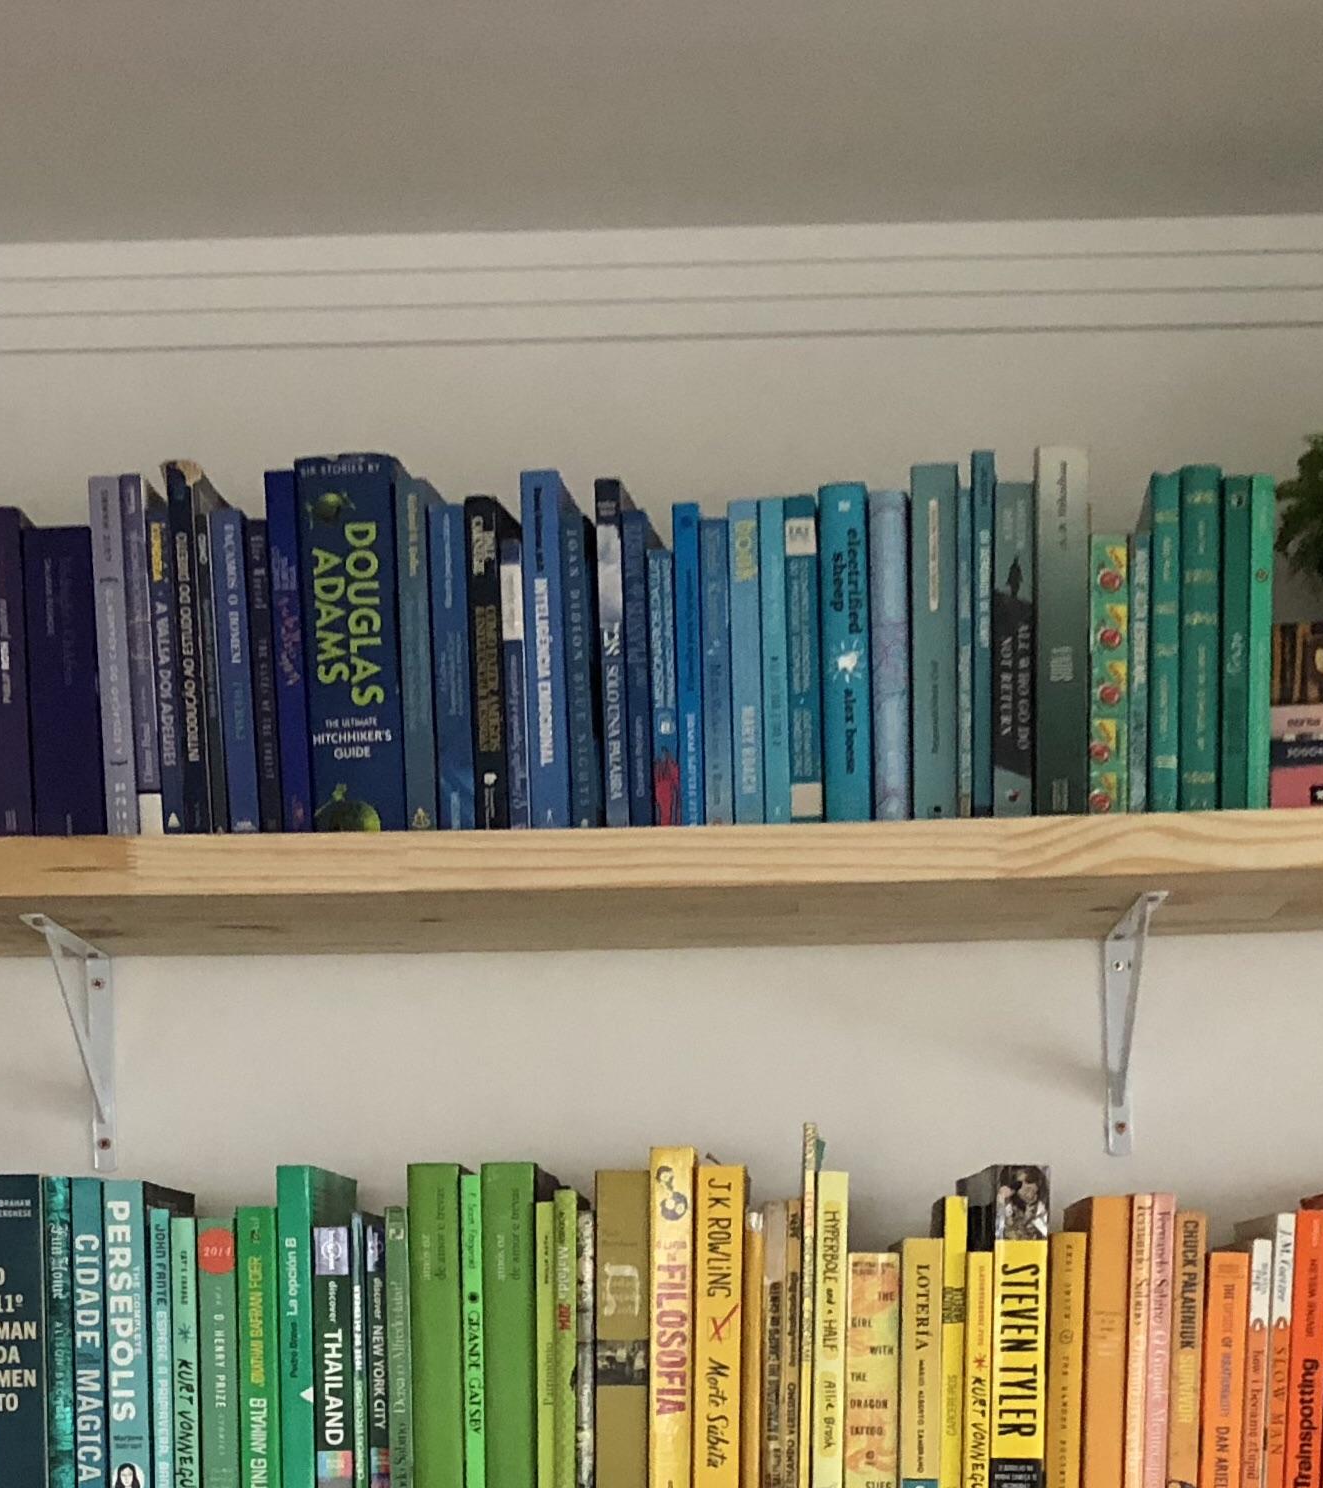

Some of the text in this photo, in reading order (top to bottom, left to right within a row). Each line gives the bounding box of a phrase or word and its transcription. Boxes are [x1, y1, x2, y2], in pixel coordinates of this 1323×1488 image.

[321, 464, 364, 476] STORIES
[829, 551, 847, 612] sheep
[845, 527, 864, 635] electrified
[155, 617, 171, 664] VALSA
[180, 607, 195, 655] ESTUDO
[311, 547, 350, 685] ADAMS
[344, 521, 385, 707] DOUGLAS
[313, 728, 392, 747] HITCHHIKER'S
[325, 716, 378, 729] THE ULTIMATE
[333, 745, 372, 760] GUIDE
[153, 1223, 167, 1307] JOHN FANTE
[821, 1210, 838, 1283] HYPERBOLE
[75, 1233, 100, 1348] CIDADE
[284, 1252, 298, 1296] opción
[557, 1245, 571, 1332] Mafalda 2014
[877, 1291, 896, 1301] THE
[1178, 1219, 1200, 1349] CHUCK PALAHNIUK
[107, 1200, 135, 1422] PERSEPOLIS
[132, 1265, 143, 1355] THE COMPLETE
[286, 1299, 298, 1316] La
[851, 1318, 872, 1328] GIRL
[915, 1263, 930, 1351] LOTERÍA
[372, 1277, 387, 1430] discover NEW YORK CITY
[656, 1263, 687, 1416] FILOSOFIA
[821, 1318, 838, 1353] HALF
[869, 1345, 894, 1356] WITH
[997, 1263, 1040, 1438] STEVEN TYLER
[177, 1357, 195, 1404] KURT
[214, 1329, 226, 1408] HENRY PRIZE
[323, 1280, 344, 1446] discover THAILAND
[467, 1310, 482, 1436] GRANDE GATSBY
[705, 1357, 730, 1407] Morte
[850, 1372, 867, 1382] THE
[850, 1399, 888, 1410] DRAGON
[970, 1376, 986, 1417] KURT
[1268, 1346, 1286, 1456] SLOW MAN
[249, 1397, 269, 1453] ANIMALS
[850, 1425, 884, 1436] TATTOO
[1215, 1425, 1231, 1453] DAN
[1245, 1440, 1260, 1479] stupid
